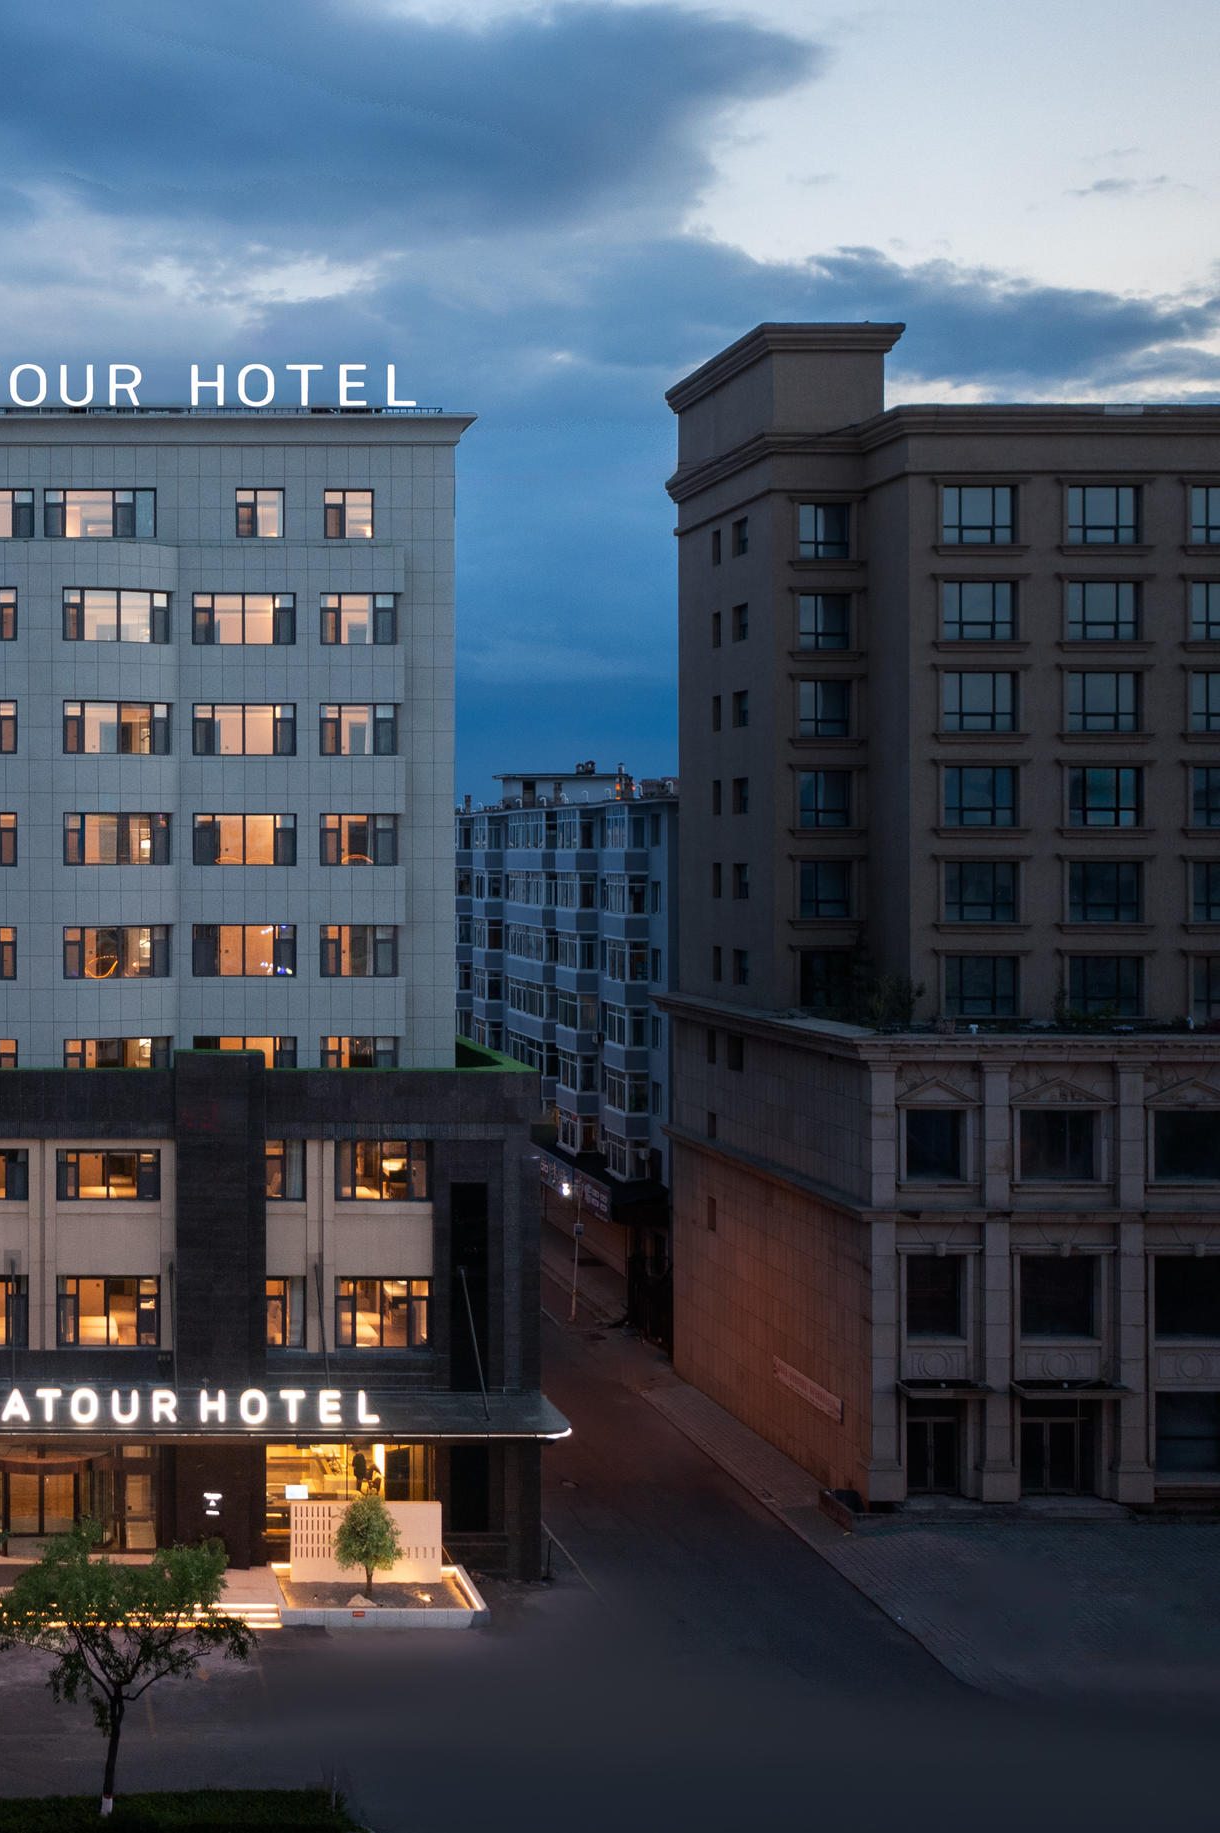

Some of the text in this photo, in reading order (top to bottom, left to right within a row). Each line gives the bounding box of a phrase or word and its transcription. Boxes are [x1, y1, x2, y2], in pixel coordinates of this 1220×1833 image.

[190, 363, 417, 407] HOTEL
[1, 1387, 178, 1426] ATOUR
[199, 1387, 381, 1426] HOTEL
